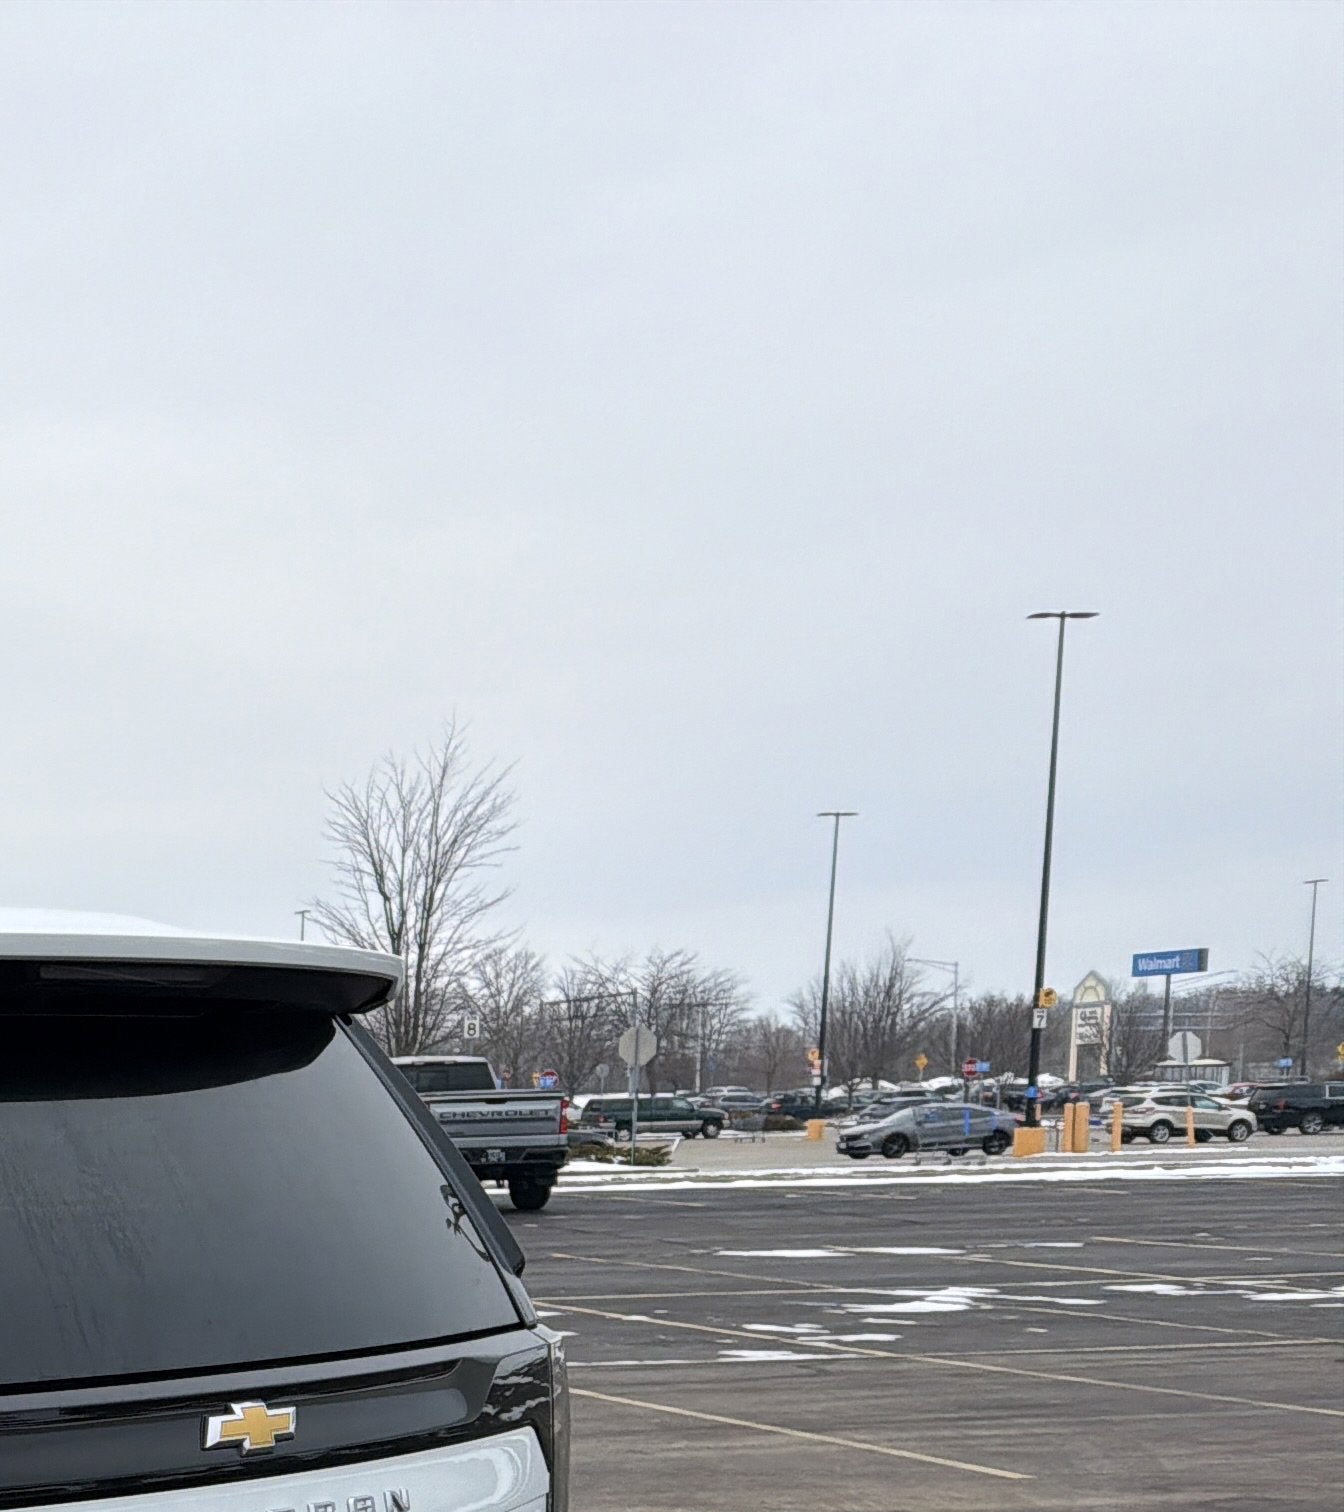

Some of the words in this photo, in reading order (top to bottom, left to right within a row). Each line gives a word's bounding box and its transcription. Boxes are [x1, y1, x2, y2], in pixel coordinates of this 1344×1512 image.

[1137, 955, 1180, 971] Walmart
[1037, 1014, 1045, 1027] 7
[467, 1022, 476, 1036] 8
[439, 1109, 550, 1119] CHEVROLET
